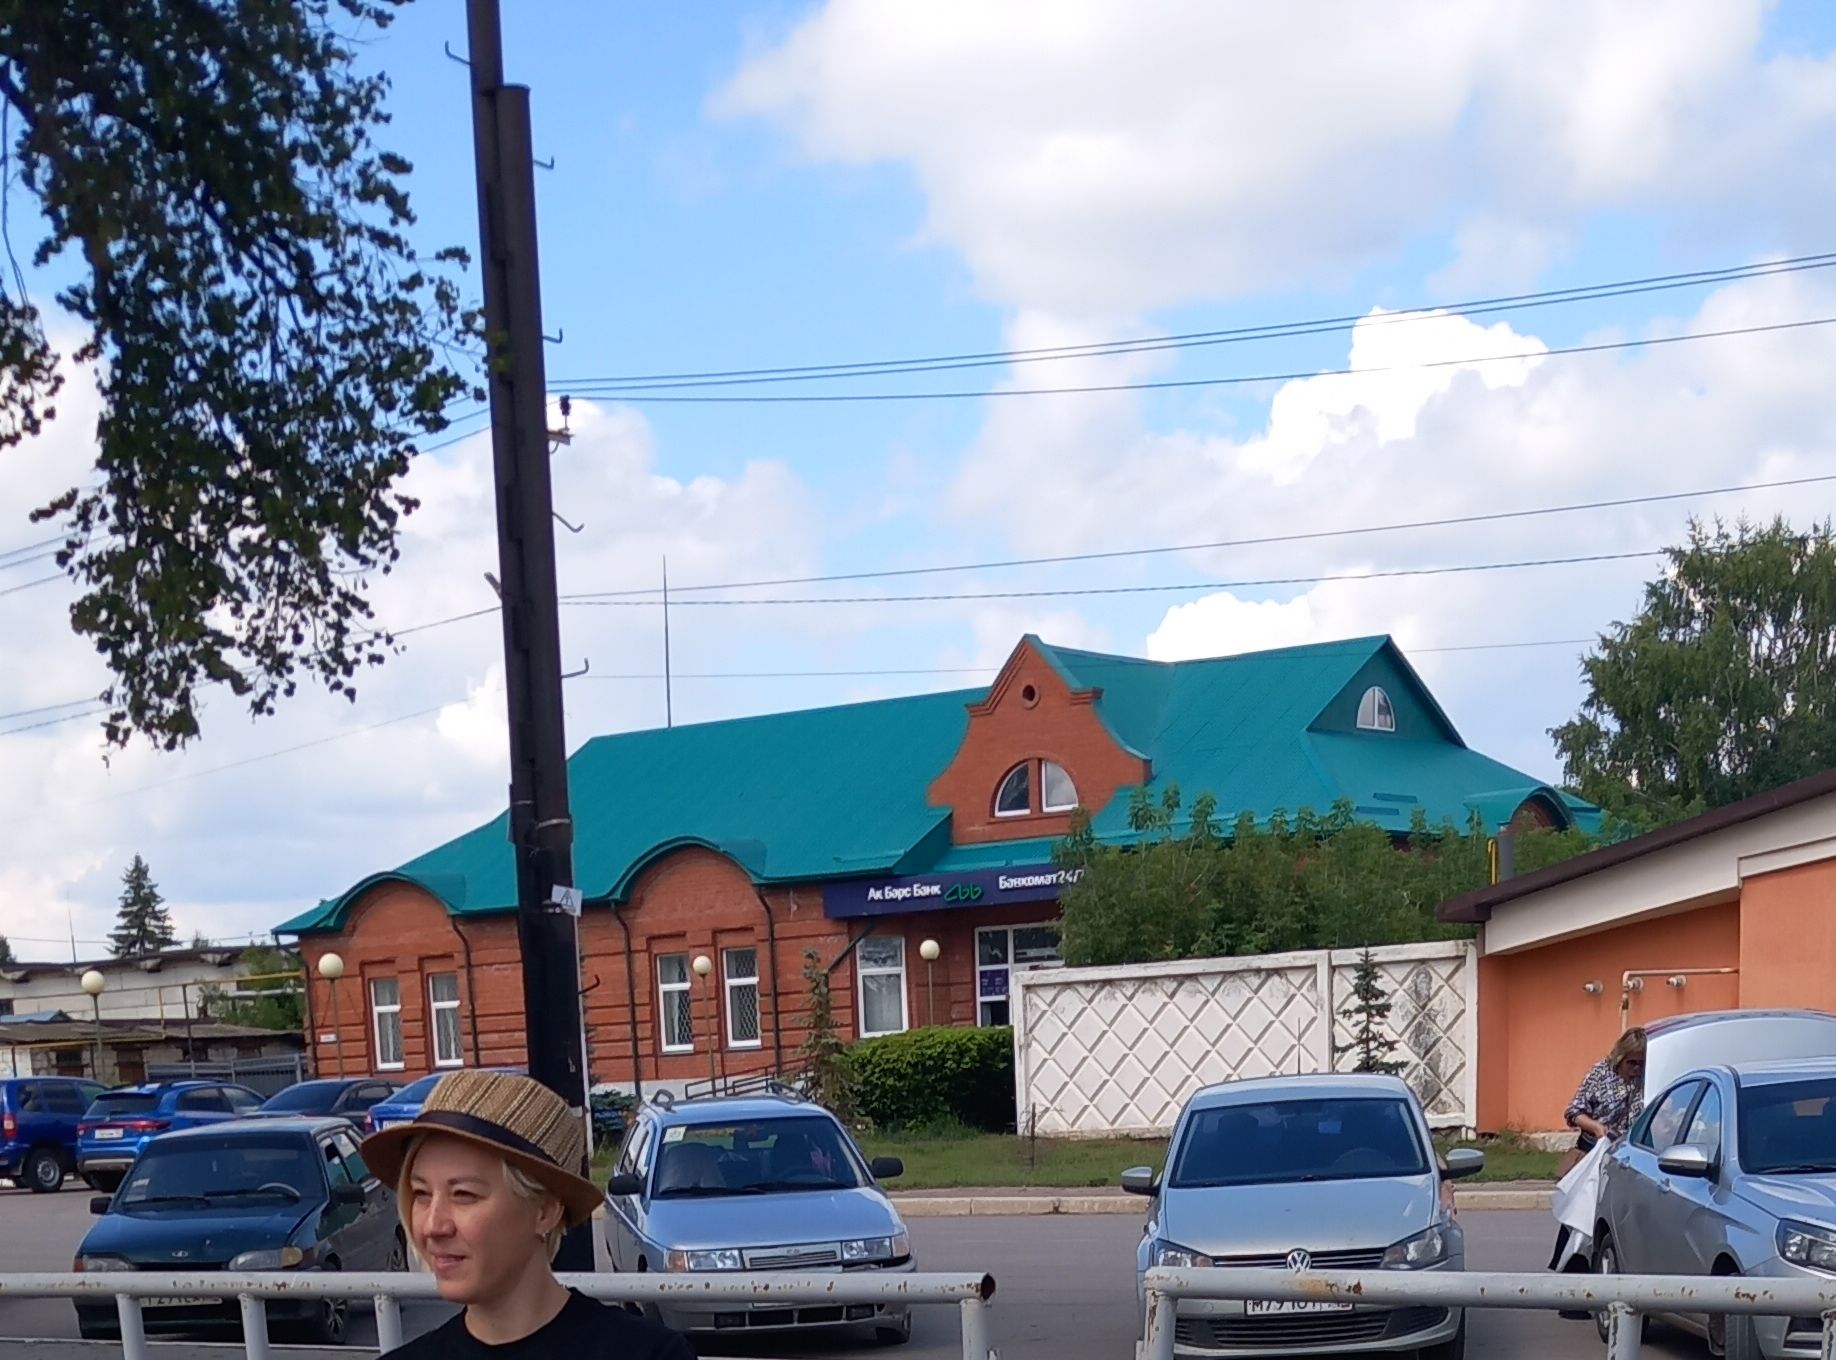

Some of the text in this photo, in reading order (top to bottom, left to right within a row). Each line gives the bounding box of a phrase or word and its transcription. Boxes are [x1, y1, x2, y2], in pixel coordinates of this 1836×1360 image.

[867, 882, 942, 901] Ак Барс Банк
